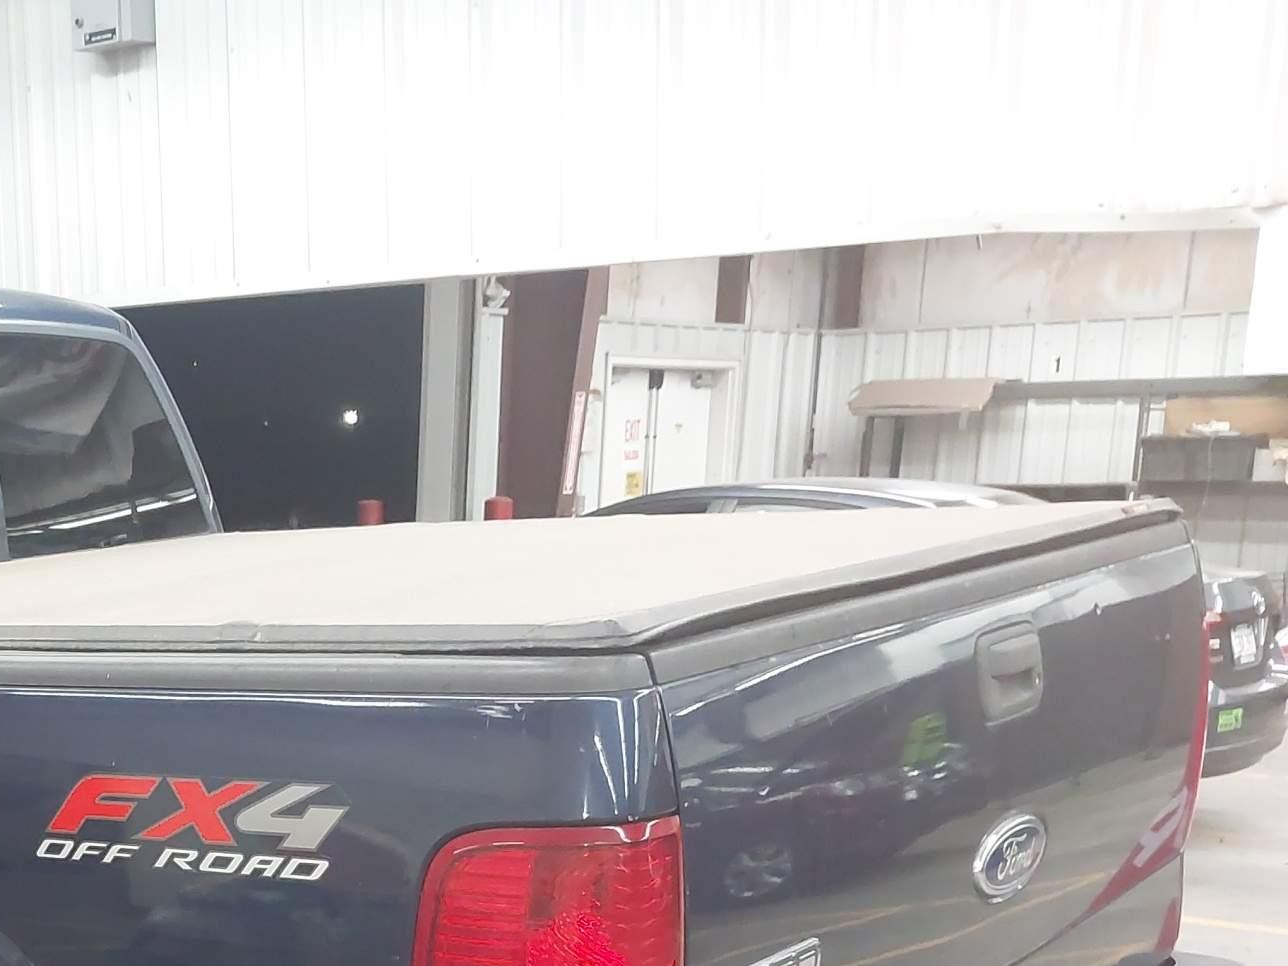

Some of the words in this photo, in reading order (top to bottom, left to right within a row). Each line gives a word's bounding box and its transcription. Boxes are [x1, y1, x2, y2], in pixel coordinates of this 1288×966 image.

[45, 774, 350, 852] FX4
[36, 838, 138, 864] OFF
[153, 849, 331, 882] ROAD
[997, 832, 1039, 881] Ford
